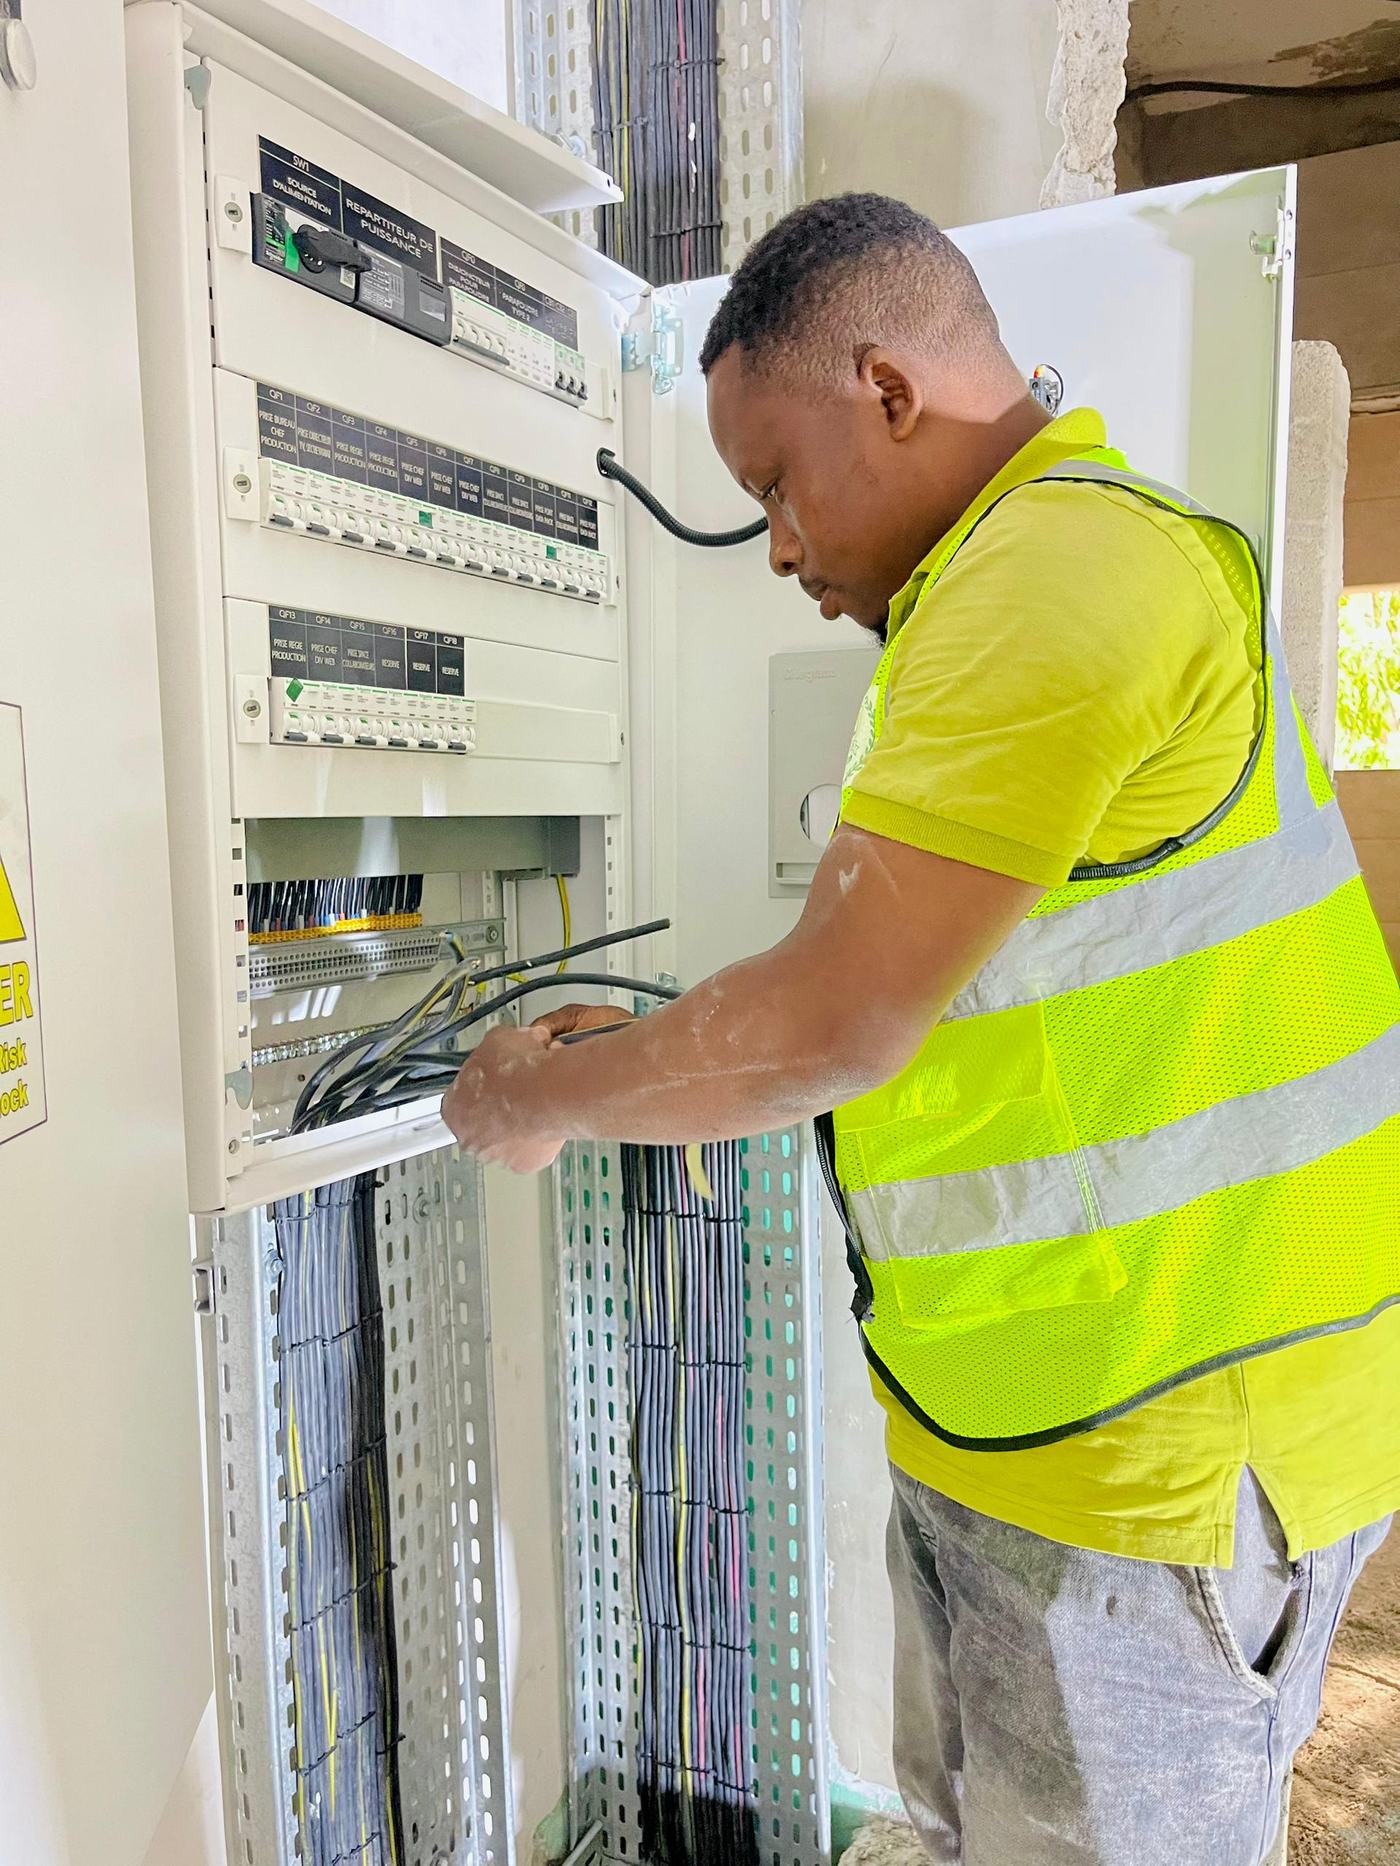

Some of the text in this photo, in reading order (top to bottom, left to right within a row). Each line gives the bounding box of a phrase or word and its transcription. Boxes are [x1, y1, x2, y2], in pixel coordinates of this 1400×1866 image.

[292, 155, 310, 173] SW1
[286, 176, 317, 199] SOURCE
[272, 178, 332, 217] D'ALIMENTATION
[345, 198, 434, 254] REPARTITEUR DE
[360, 218, 423, 259] PUISSANCE
[269, 389, 283, 401] QF1
[306, 402, 321, 414] QF2
[342, 414, 356, 426] QF3
[270, 426, 285, 438] CHEF
[375, 426, 388, 438] QF4
[261, 434, 298, 454] PRODUCTION
[406, 436, 419, 447] QF5
[334, 451, 367, 469] PRODUCTION
[278, 609, 297, 620] QF13
[315, 615, 331, 625] QF14
[349, 620, 366, 631] QF15
[414, 630, 429, 641] QF17
[442, 635, 458, 646] QF18
[273, 638, 288, 648] PRISE
[310, 643, 324, 654] PRISE
[324, 645, 338, 655] CHEF
[271, 650, 307, 663] PRODUCTION
[0, 1078, 29, 1118] ock
